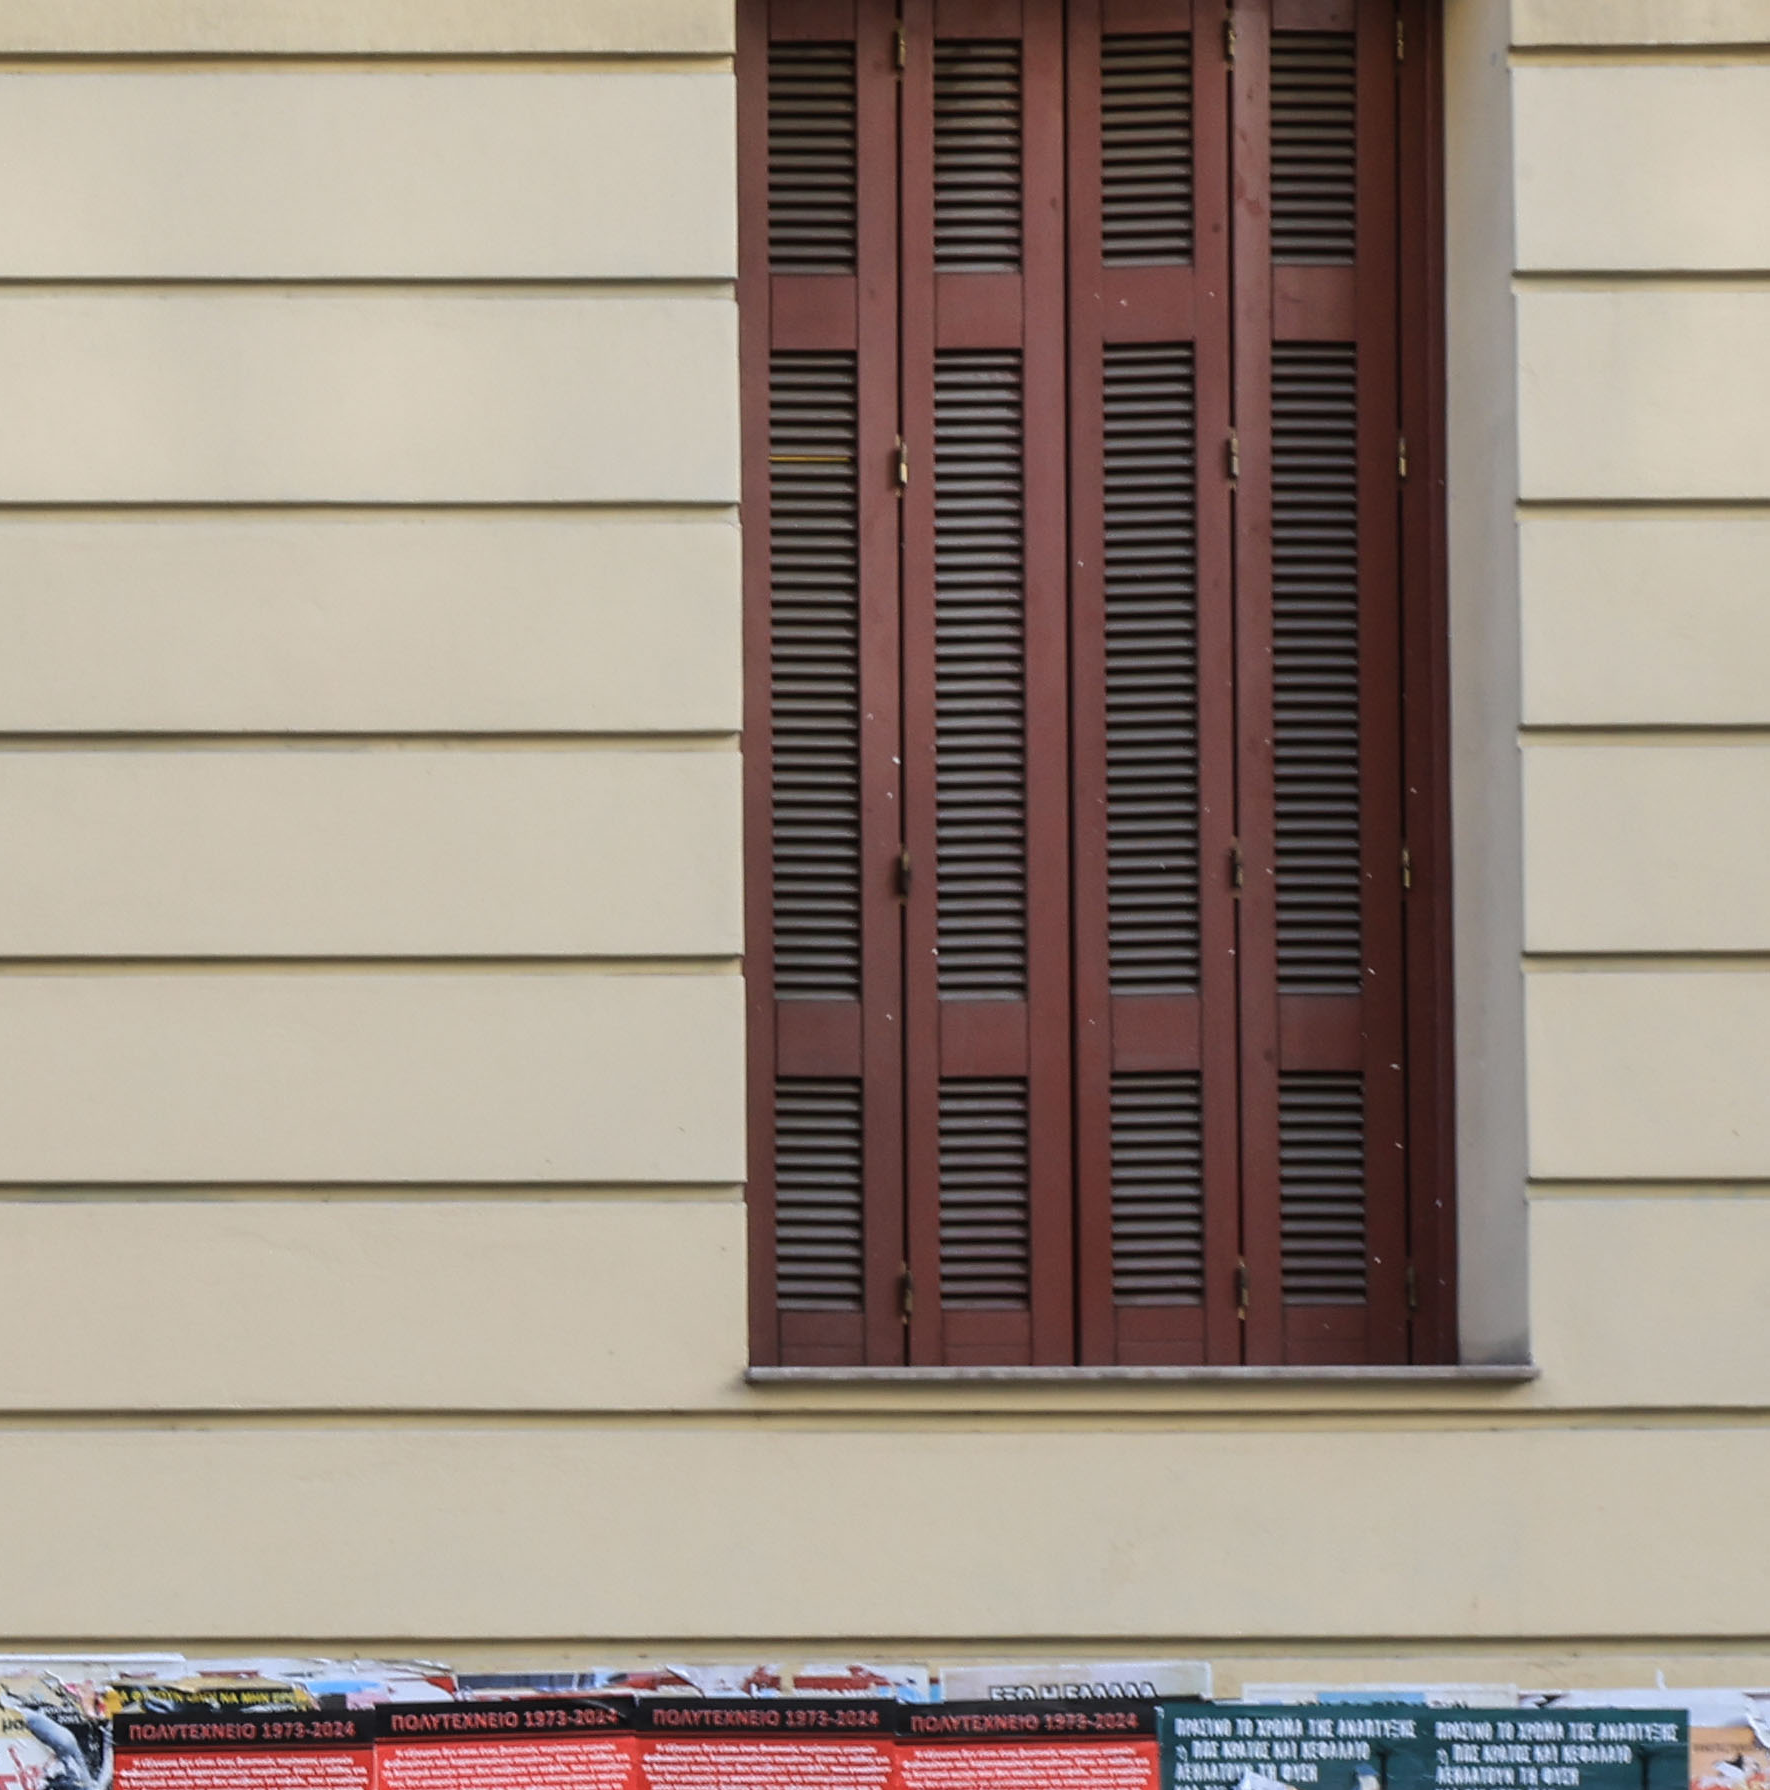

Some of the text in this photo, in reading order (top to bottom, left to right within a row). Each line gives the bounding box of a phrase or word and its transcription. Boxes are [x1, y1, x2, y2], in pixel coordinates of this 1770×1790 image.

[390, 1707, 619, 1732] ΠΟΛΥΤΕΧΝΕΙΟ 1973-2024
[652, 1709, 880, 1728] ΠΟΛΥΤΕΧΝΕΙΟ 1973-2024
[909, 1710, 1139, 1732] ΠΟΛΥΤΕΧΝΕΙΟ 1973-2024
[1235, 1718, 1254, 1739] ΤΟ
[1255, 1718, 1303, 1739] ΧΡΩΜΑ
[1308, 1718, 1335, 1739] ΤΗΣ
[129, 1721, 356, 1742] ΠΟΛΥΤΕΧΝΕΙΟ 1973-2024
[1496, 1722, 1514, 1742] ΤΟ
[1568, 1721, 1595, 1742] ΤΗΣ
[1221, 1741, 1269, 1761] ΚΡΑΤΟΣ
[1272, 1742, 1297, 1762] ΚΑΙ
[1300, 1742, 1371, 1762] ΚΕΦΑΛΑΙΟ
[1481, 1744, 1530, 1765] ΚΡΑΤΟΣ
[1532, 1745, 1558, 1765] ΚΑΙ
[1560, 1745, 1632, 1766] ΚΕΦΑΛΑΙΟ
[1280, 1763, 1318, 1784] ΦΥΣΗ
[1518, 1767, 1539, 1787] ΤΗ
[1541, 1766, 1580, 1787] ΦΥΣΗ
